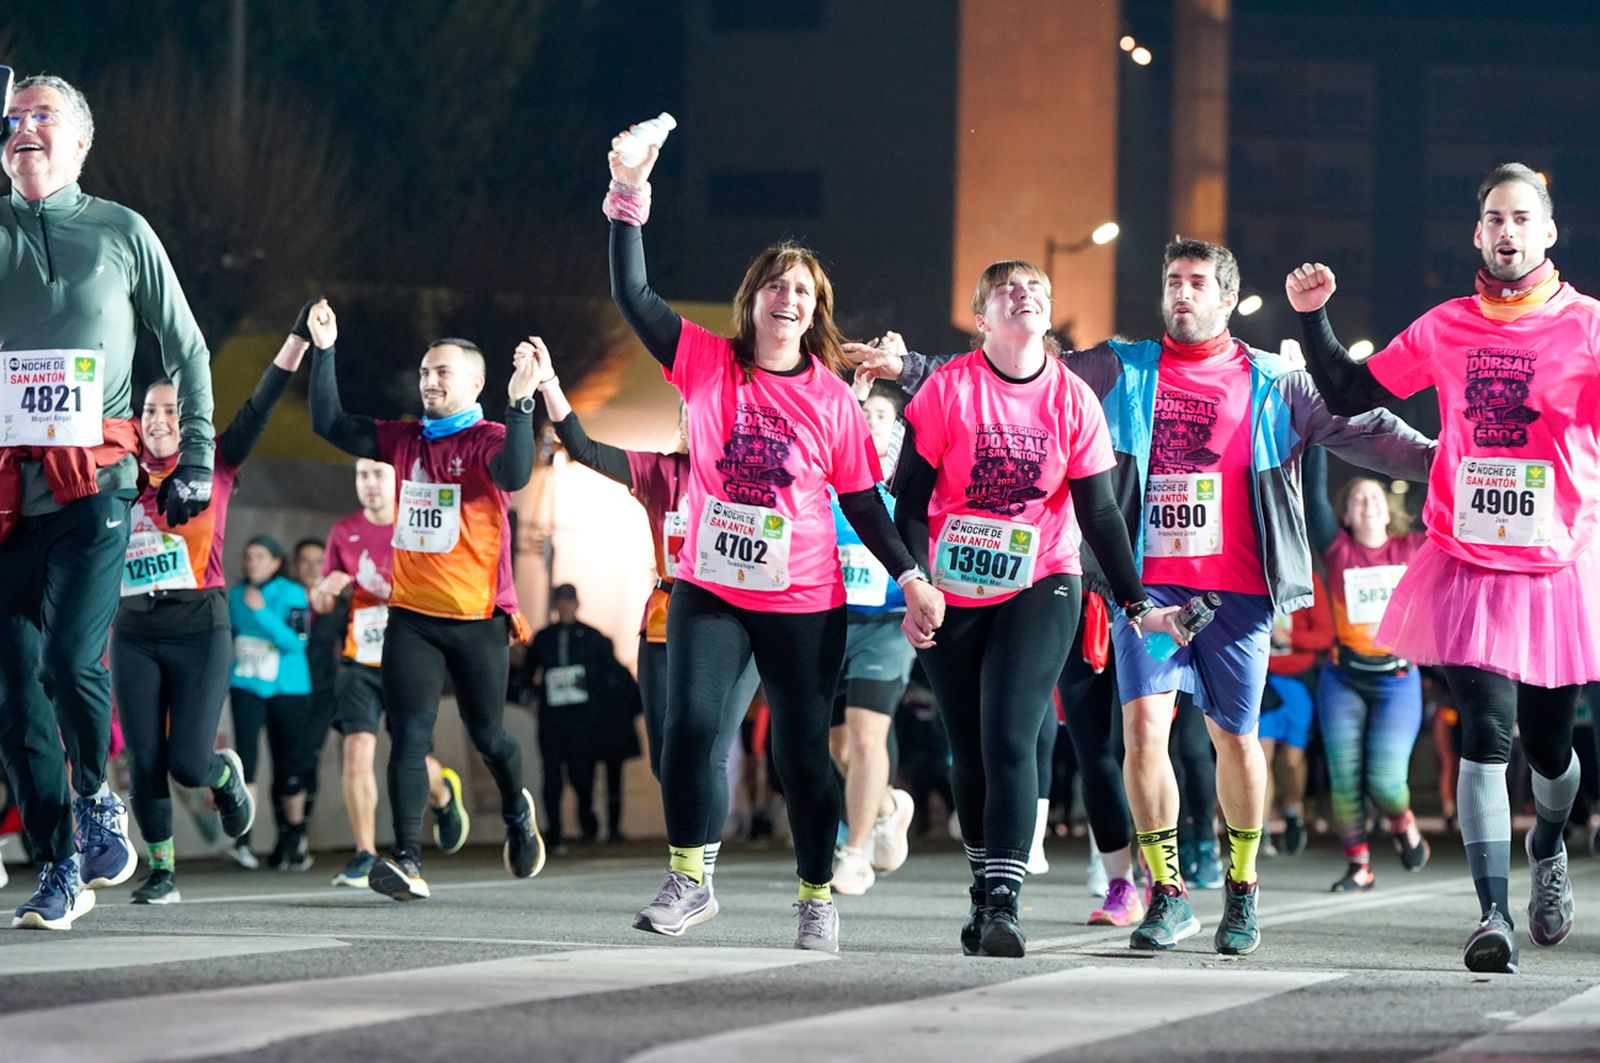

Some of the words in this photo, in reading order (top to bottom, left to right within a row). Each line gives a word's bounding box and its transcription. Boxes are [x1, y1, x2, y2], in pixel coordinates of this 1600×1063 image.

[21, 361, 51, 371] NOCHE
[53, 360, 65, 370] DE
[1468, 356, 1535, 375] DORSAL
[10, 374, 30, 385] SAN
[1479, 370, 1496, 379] SAN
[20, 384, 82, 413] 4821
[1161, 411, 1178, 420] SAN
[739, 425, 756, 436] SAN
[976, 424, 988, 433] HE
[989, 423, 1048, 439] CONSEGUIDO
[977, 433, 1047, 455] DORSAL
[988, 448, 1008, 458] SAN
[1476, 467, 1503, 477] NOCHE
[1505, 468, 1517, 477] DE
[1466, 475, 1484, 486] SAN
[1152, 483, 1176, 492] NOCHE
[1178, 484, 1188, 492] DE
[1146, 494, 1159, 503] SAN
[1471, 488, 1535, 517] 4906
[408, 507, 442, 529] 2116
[722, 509, 746, 522] NOCHE
[1149, 503, 1206, 529] 4690
[710, 517, 726, 529] SAN
[960, 524, 989, 537] NOCHE
[990, 529, 1003, 538] DE
[714, 531, 768, 565] 4702
[947, 533, 966, 545] SAN
[968, 536, 1002, 550] ANTÓN
[125, 551, 178, 581] 12667
[947, 545, 1022, 581] 13907
[978, 576, 988, 585] del
[989, 578, 1002, 586] Mar
[1358, 587, 1396, 603] 583
